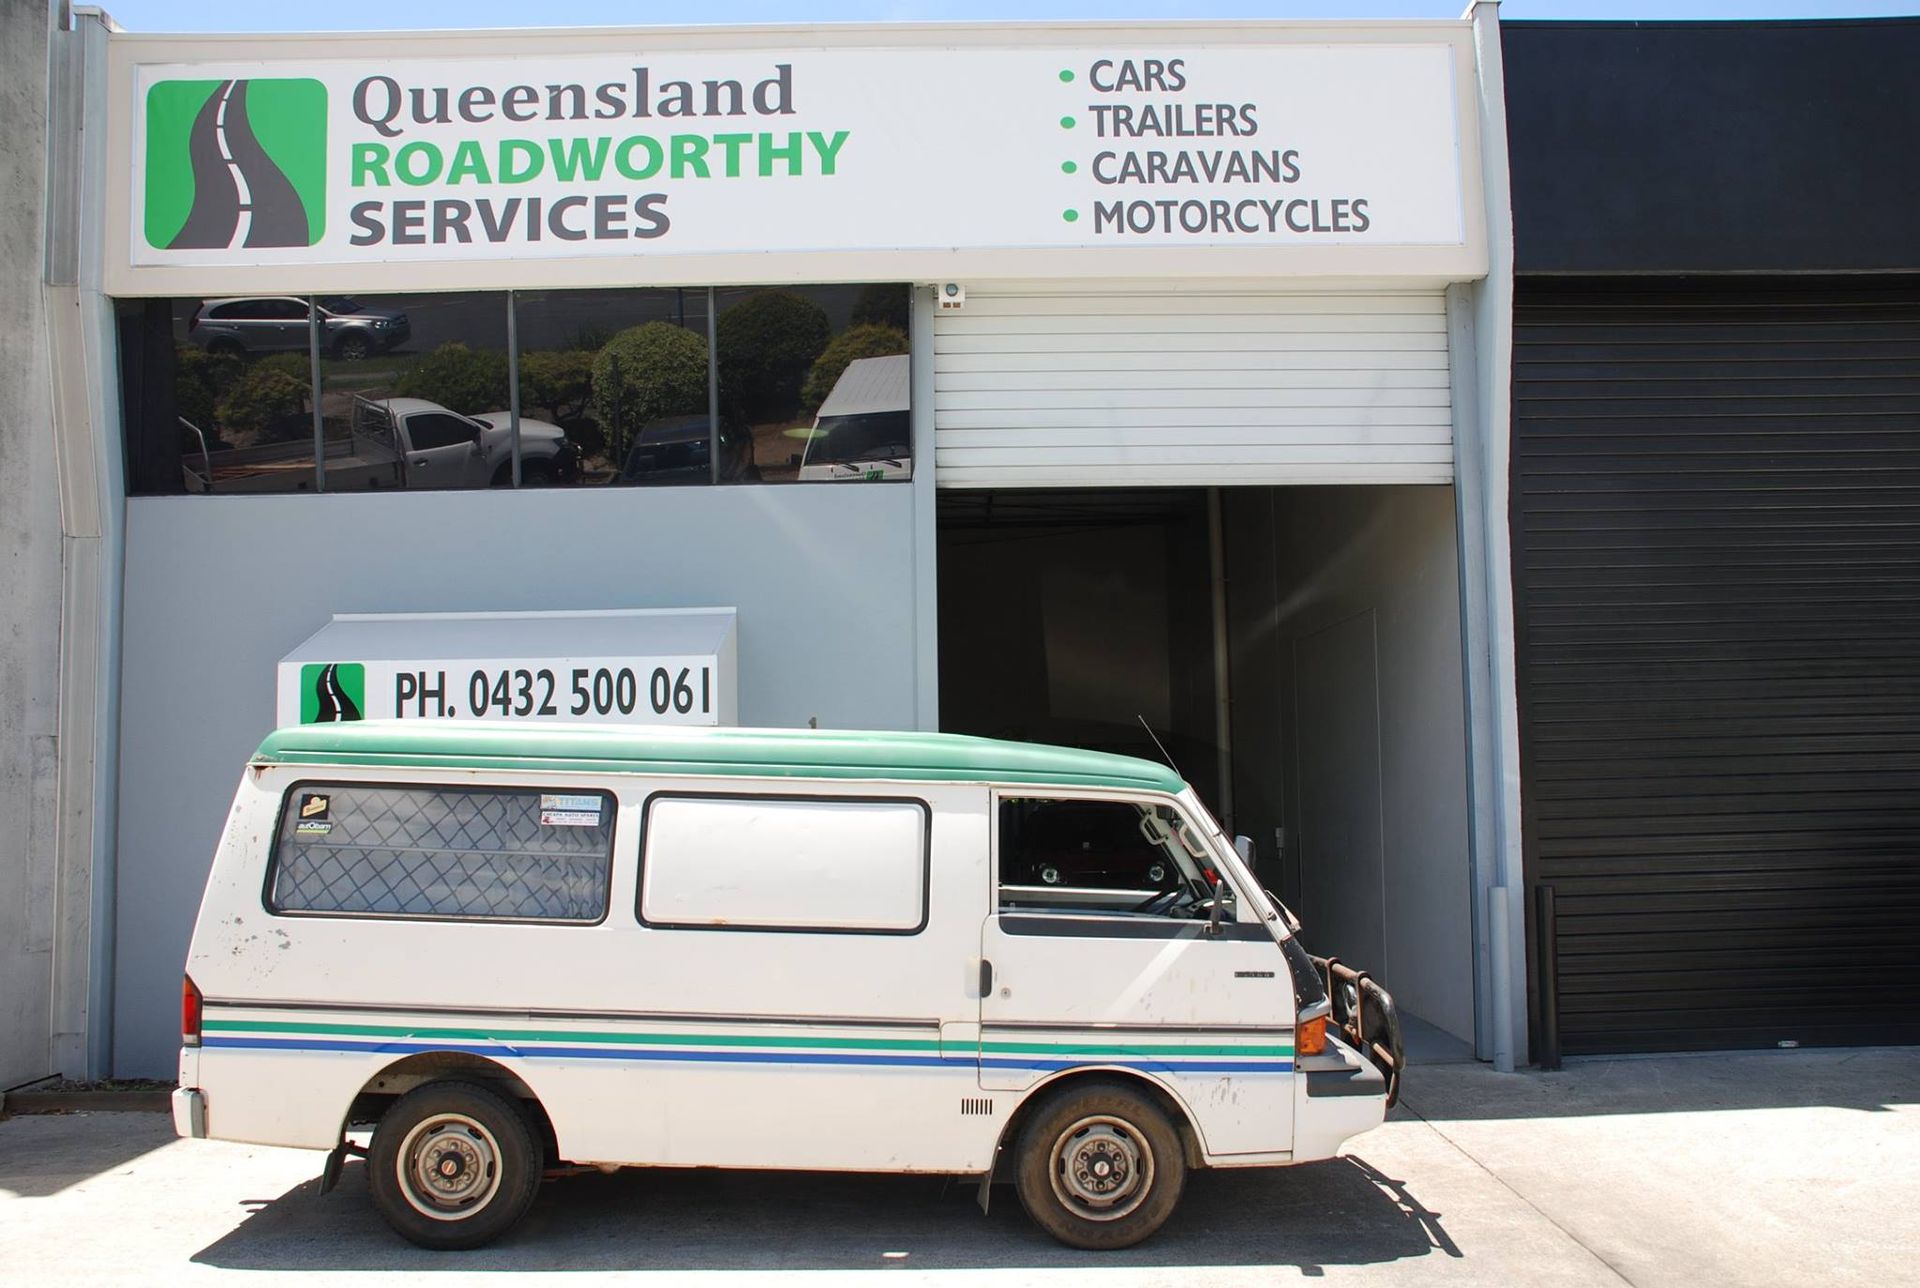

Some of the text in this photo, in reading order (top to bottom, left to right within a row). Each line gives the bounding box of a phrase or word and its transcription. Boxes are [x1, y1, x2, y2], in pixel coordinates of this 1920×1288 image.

[1089, 58, 1186, 92] CARS
[353, 63, 796, 137] Queensland
[1088, 103, 1258, 137] TRAILERS
[351, 131, 850, 187] ROADWORTHY
[1092, 150, 1300, 184] CARAVANS
[349, 193, 671, 246] SERVICES
[1094, 199, 1370, 234] MOTORCYCLES
[396, 666, 710, 718] PH. 0432 500 061
